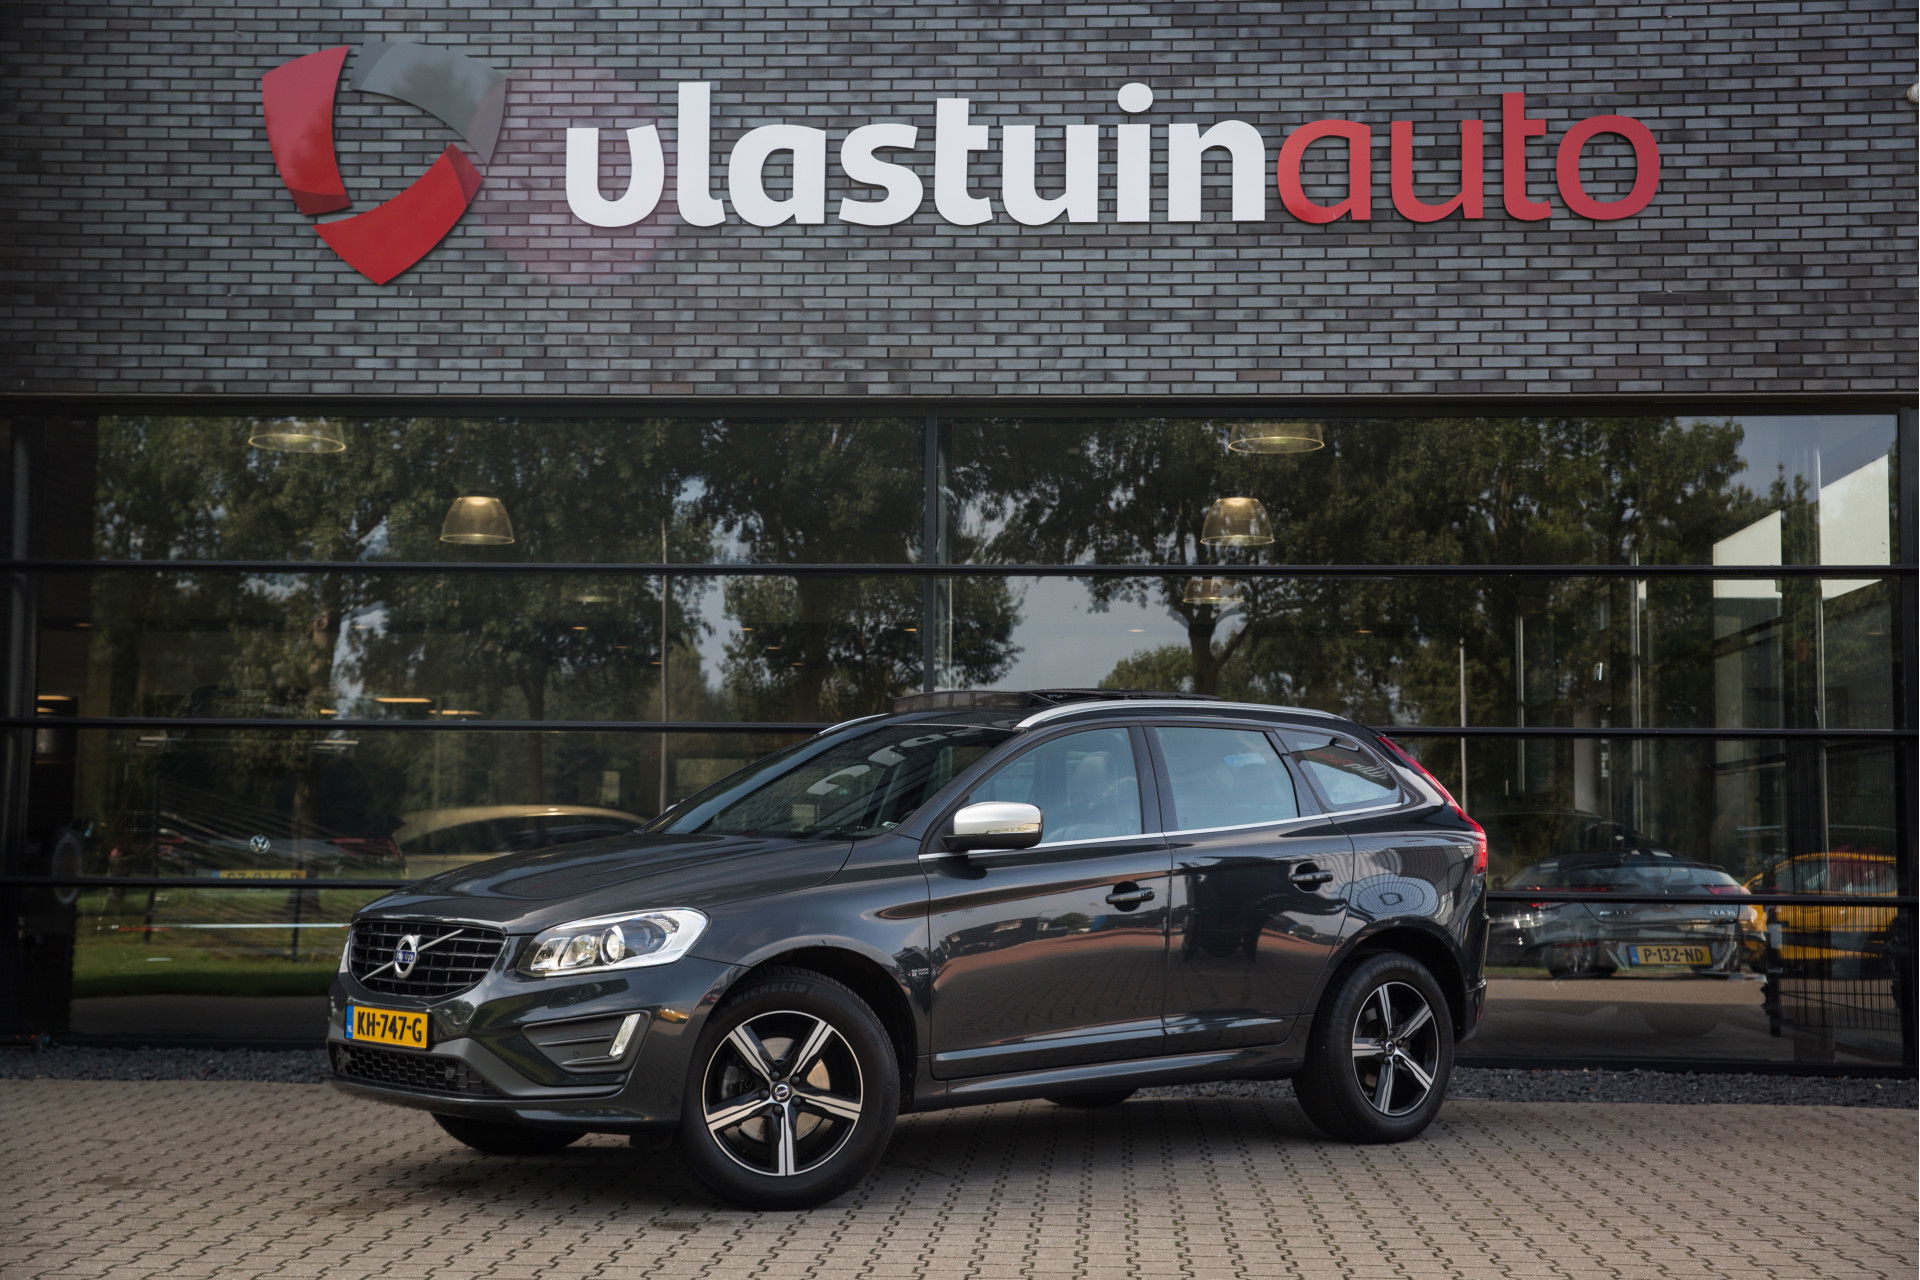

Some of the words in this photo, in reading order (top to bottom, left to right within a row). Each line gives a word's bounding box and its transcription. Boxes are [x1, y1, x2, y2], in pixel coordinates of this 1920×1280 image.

[566, 82, 1661, 228] vlastuinauto
[1643, 948, 1704, 962] P-132-ND
[357, 1011, 422, 1043] KH-747-G
